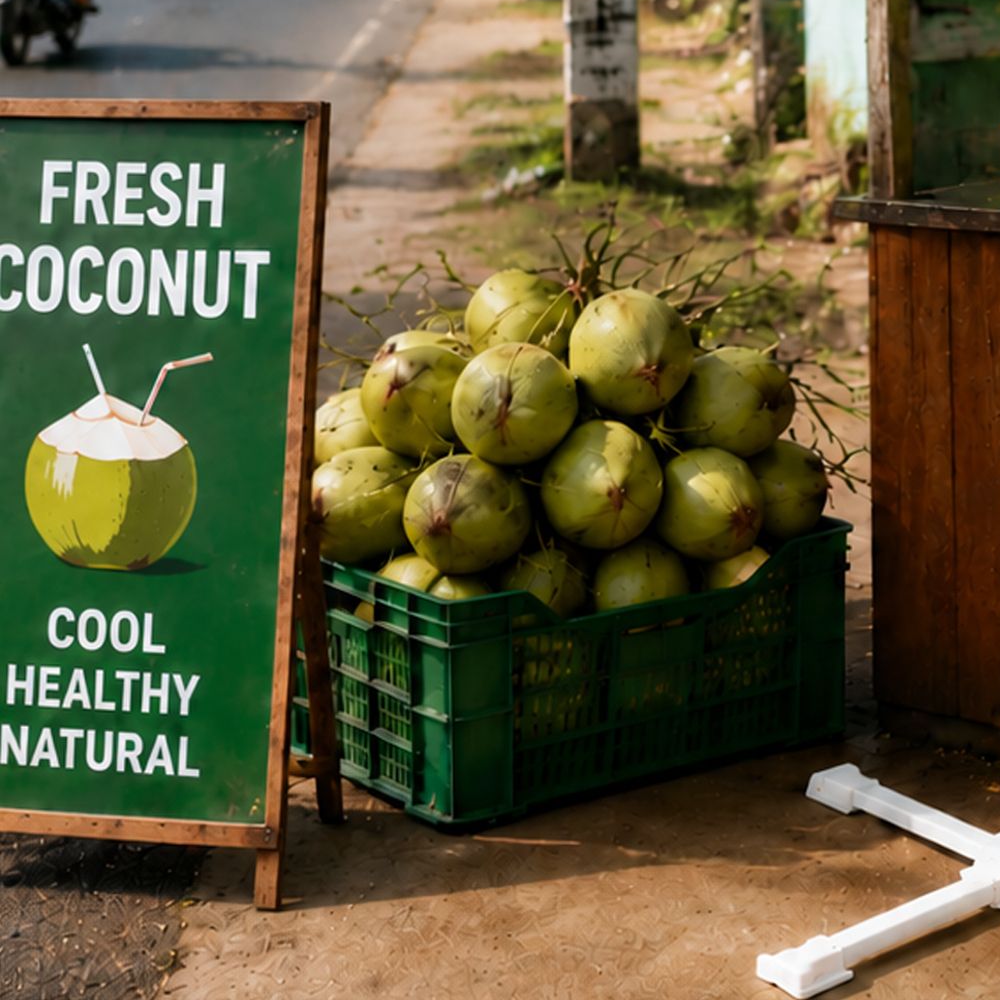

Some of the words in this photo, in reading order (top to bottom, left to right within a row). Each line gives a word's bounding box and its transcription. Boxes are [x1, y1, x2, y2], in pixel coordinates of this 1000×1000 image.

[40, 160, 225, 228] FRESH
[0, 243, 271, 319] COCONUT
[47, 606, 166, 654] COOL
[6, 663, 201, 716] HEALTHY
[0, 723, 200, 778] NATURAL
